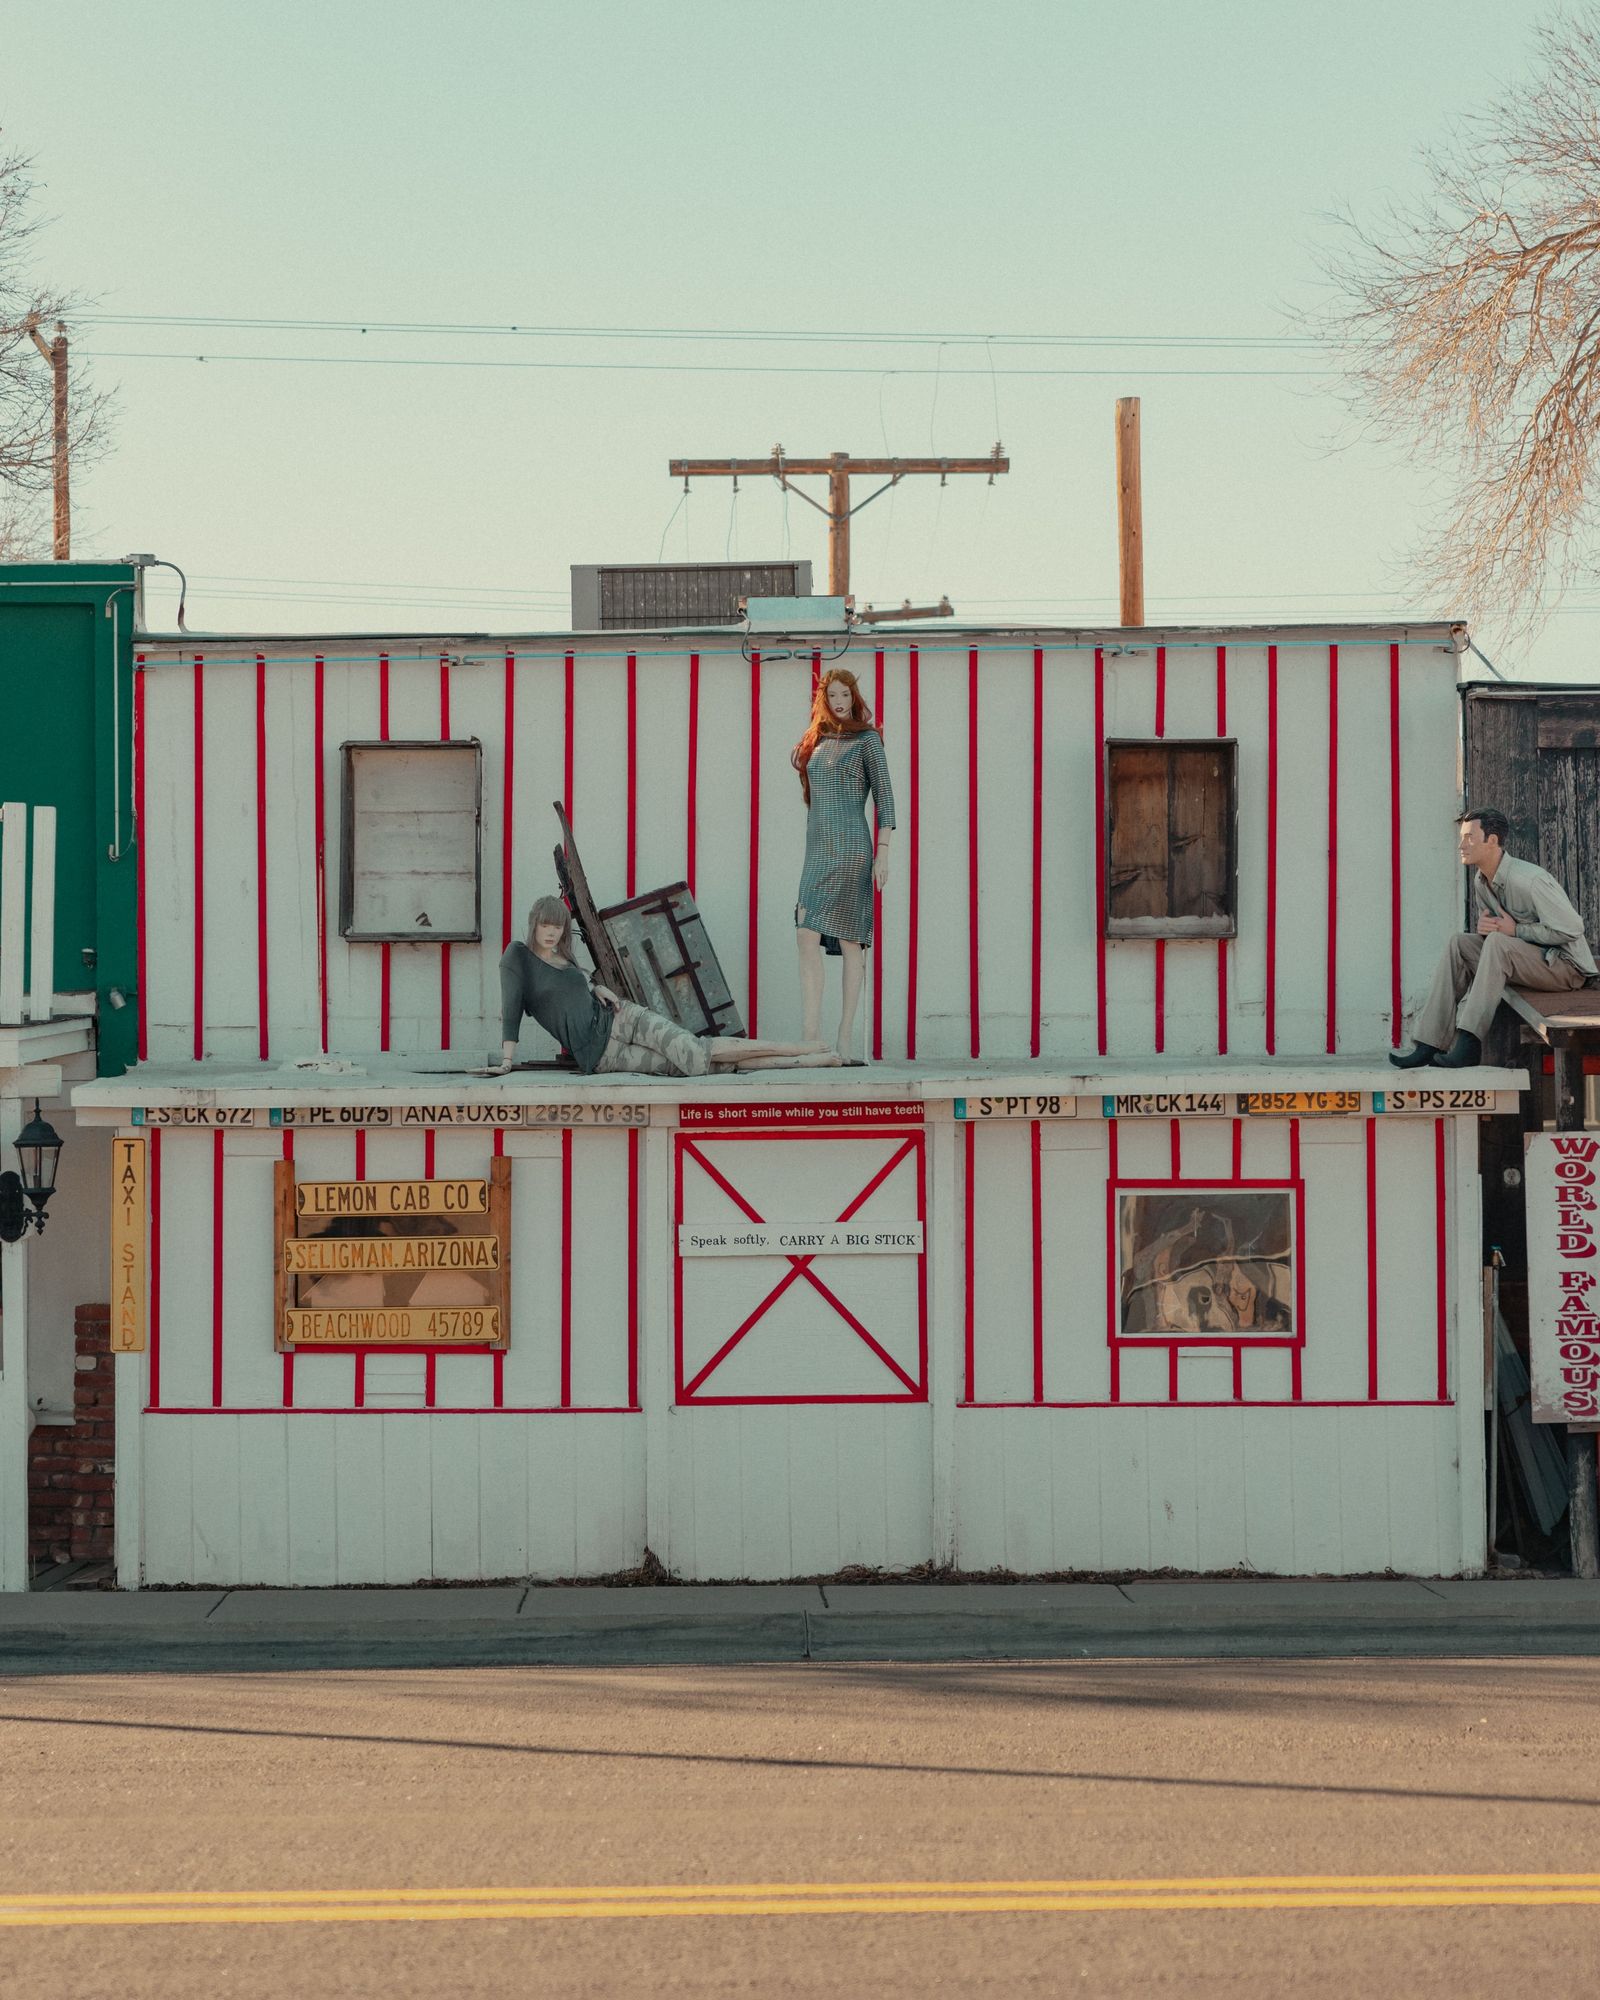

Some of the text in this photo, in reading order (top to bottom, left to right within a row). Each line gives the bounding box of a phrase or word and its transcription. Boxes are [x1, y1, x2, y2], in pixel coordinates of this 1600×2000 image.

[980, 1096, 1060, 1115] S PT 98
[1117, 1095, 1142, 1113] MR
[1249, 1092, 1297, 1109] 2852
[1335, 1091, 1358, 1108] 35
[1393, 1089, 1486, 1109] S PS 228
[145, 1107, 170, 1122] ES
[185, 1107, 209, 1123] CK
[283, 1107, 295, 1123] B
[310, 1107, 335, 1123] PE
[405, 1105, 453, 1122] ANA
[680, 1104, 924, 1120] Life is short smile while you still have teeth
[314, 1183, 469, 1212] LEMON CAB CO
[121, 1143, 137, 1347] TAXI STAND
[690, 1234, 727, 1248] Speak
[779, 1235, 825, 1246] CARRY
[830, 1235, 839, 1245] A
[846, 1234, 870, 1245] BIG
[874, 1234, 916, 1245] STICK
[402, 1241, 489, 1267] ARIZONA
[1551, 1137, 1600, 1416] WORLD FAMOUS
[301, 1311, 484, 1339] BEACHWOOD 45789
